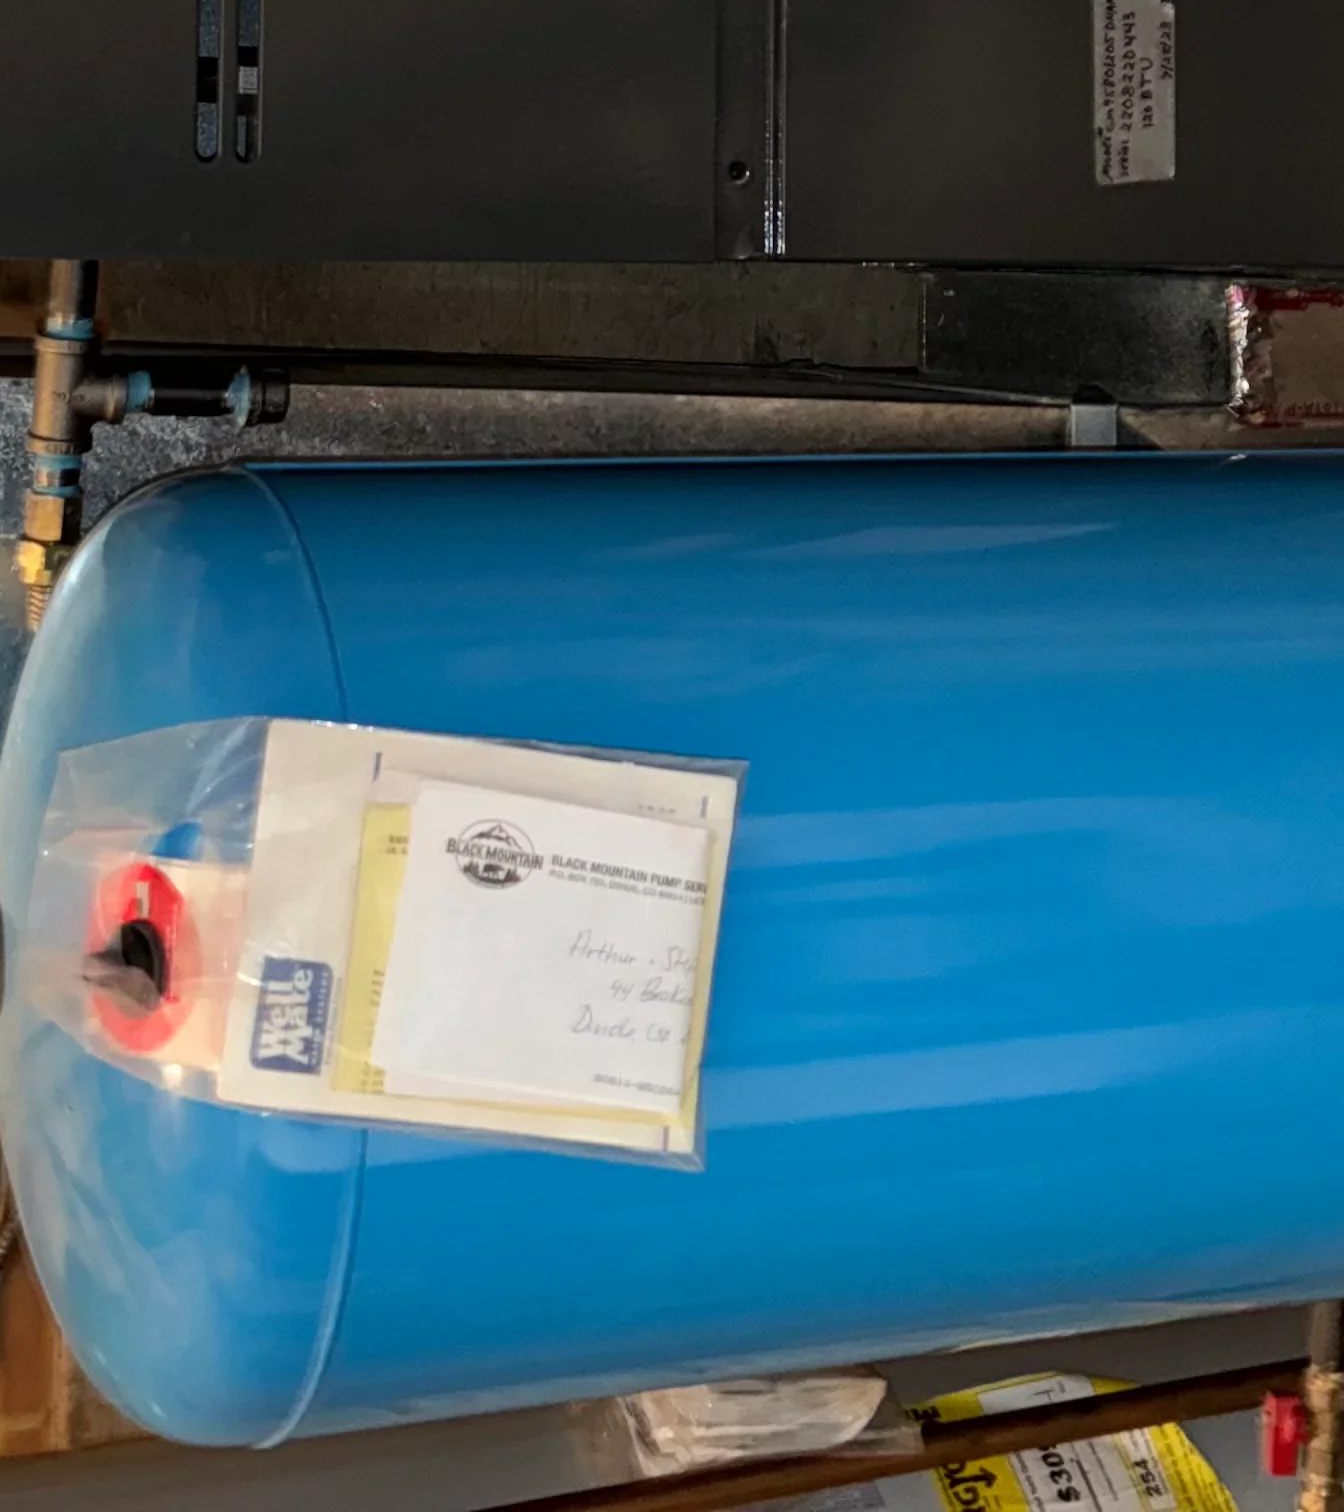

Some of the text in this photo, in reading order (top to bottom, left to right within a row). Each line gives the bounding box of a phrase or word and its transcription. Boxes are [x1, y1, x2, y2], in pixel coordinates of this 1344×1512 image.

[1140, 56, 1153, 100] BTU
[445, 836, 545, 871] BLACK MOUNTAIN
[551, 853, 588, 872] BLACK
[590, 861, 649, 883] MOUNTAIN
[650, 873, 682, 889] PUMP
[257, 980, 295, 1060] Well
[282, 968, 314, 1066] Mate
[1132, 1458, 1163, 1497] 254
